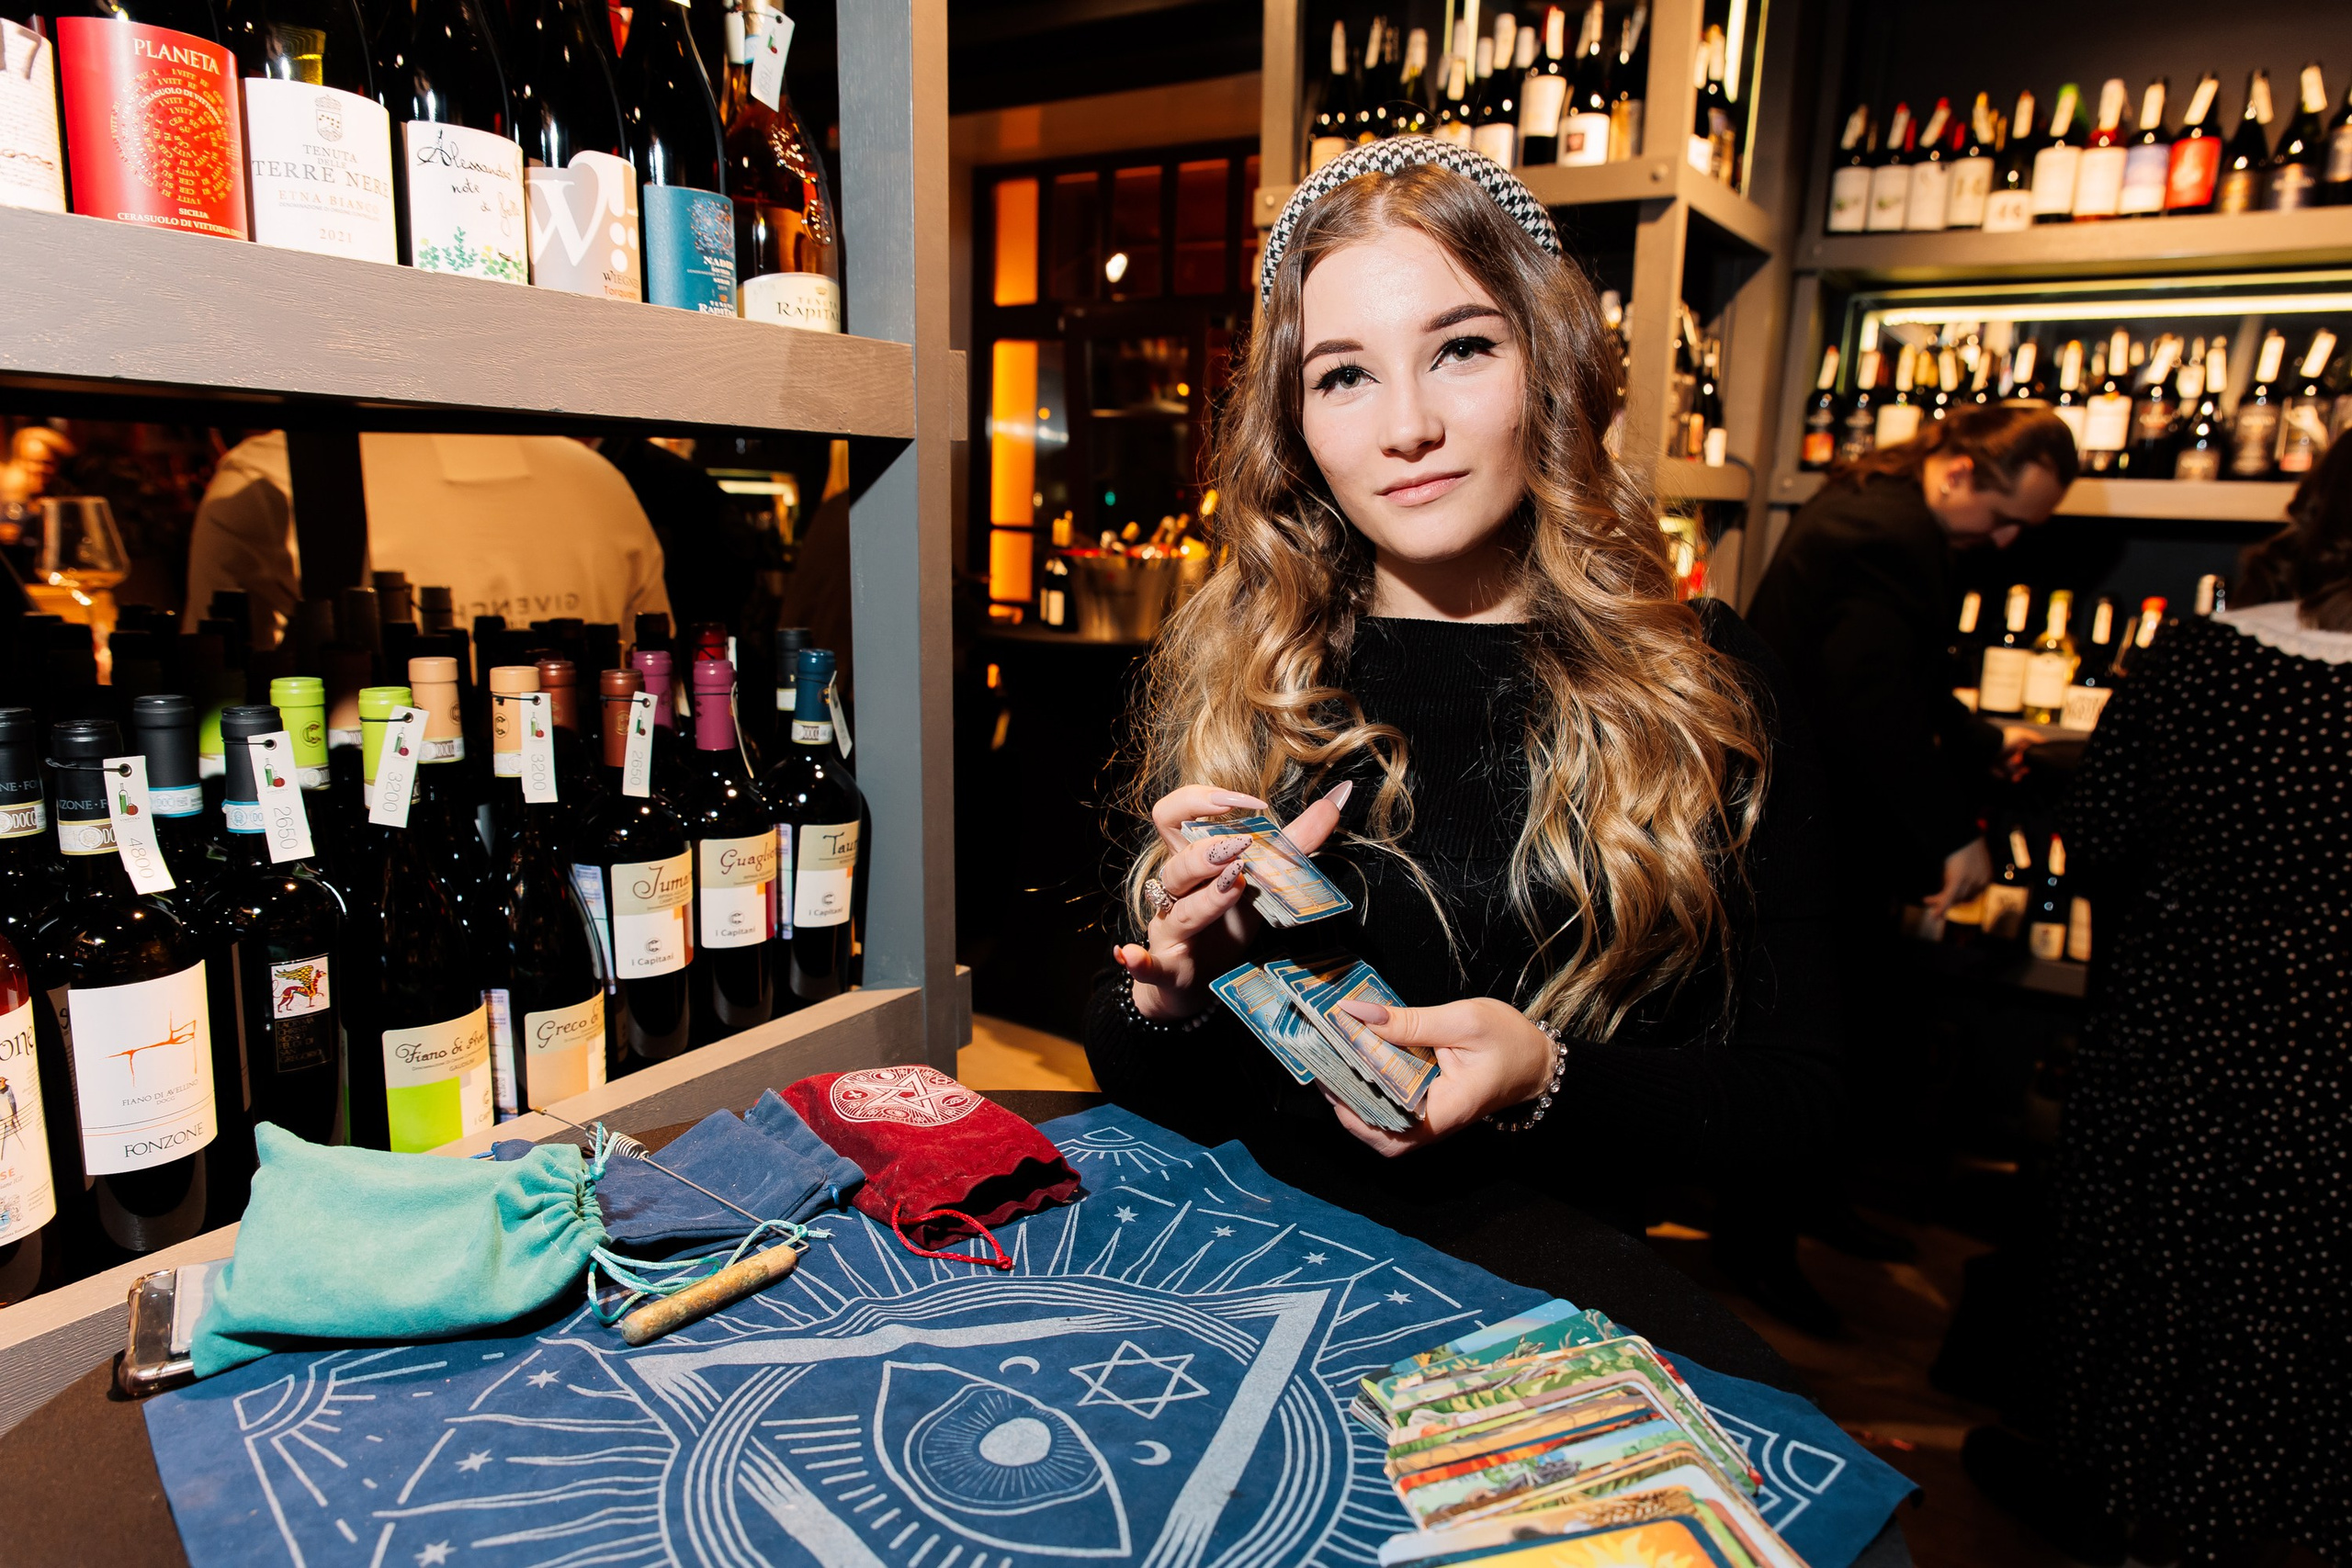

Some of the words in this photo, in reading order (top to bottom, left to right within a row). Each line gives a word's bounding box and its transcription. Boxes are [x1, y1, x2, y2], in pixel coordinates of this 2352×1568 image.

[132, 38, 220, 76] PLANETA
[138, 87, 183, 109] CERASUOLO
[183, 89, 194, 98] DI
[302, 144, 357, 164] TENUTA
[317, 157, 346, 169] DELLE
[252, 160, 335, 184] TERRE
[345, 171, 390, 198] NERE
[178, 207, 210, 220] SICILIA
[278, 190, 322, 204] ETNA
[330, 196, 380, 215] BIANCO
[117, 212, 179, 227] CERASUOLO
[180, 218, 193, 228] DI
[319, 229, 353, 243] 2021
[530, 753, 547, 792] 3200
[629, 750, 643, 786] 2650
[382, 771, 403, 813] 3200
[273, 806, 299, 850] 2650
[129, 837, 154, 879] 4800
[814, 906, 843, 918] Capitani
[721, 926, 756, 938] Capitani
[637, 953, 674, 966] Capitani
[537, 1020, 587, 1049] Greco
[395, 1043, 447, 1065] Fiano
[451, 1036, 463, 1055] di
[122, 1095, 153, 1107] FIANO
[154, 1091, 164, 1100] DI
[166, 1078, 198, 1098] AVELLINO
[156, 1096, 175, 1106] DOCG
[124, 1122, 205, 1158] FONZONE
